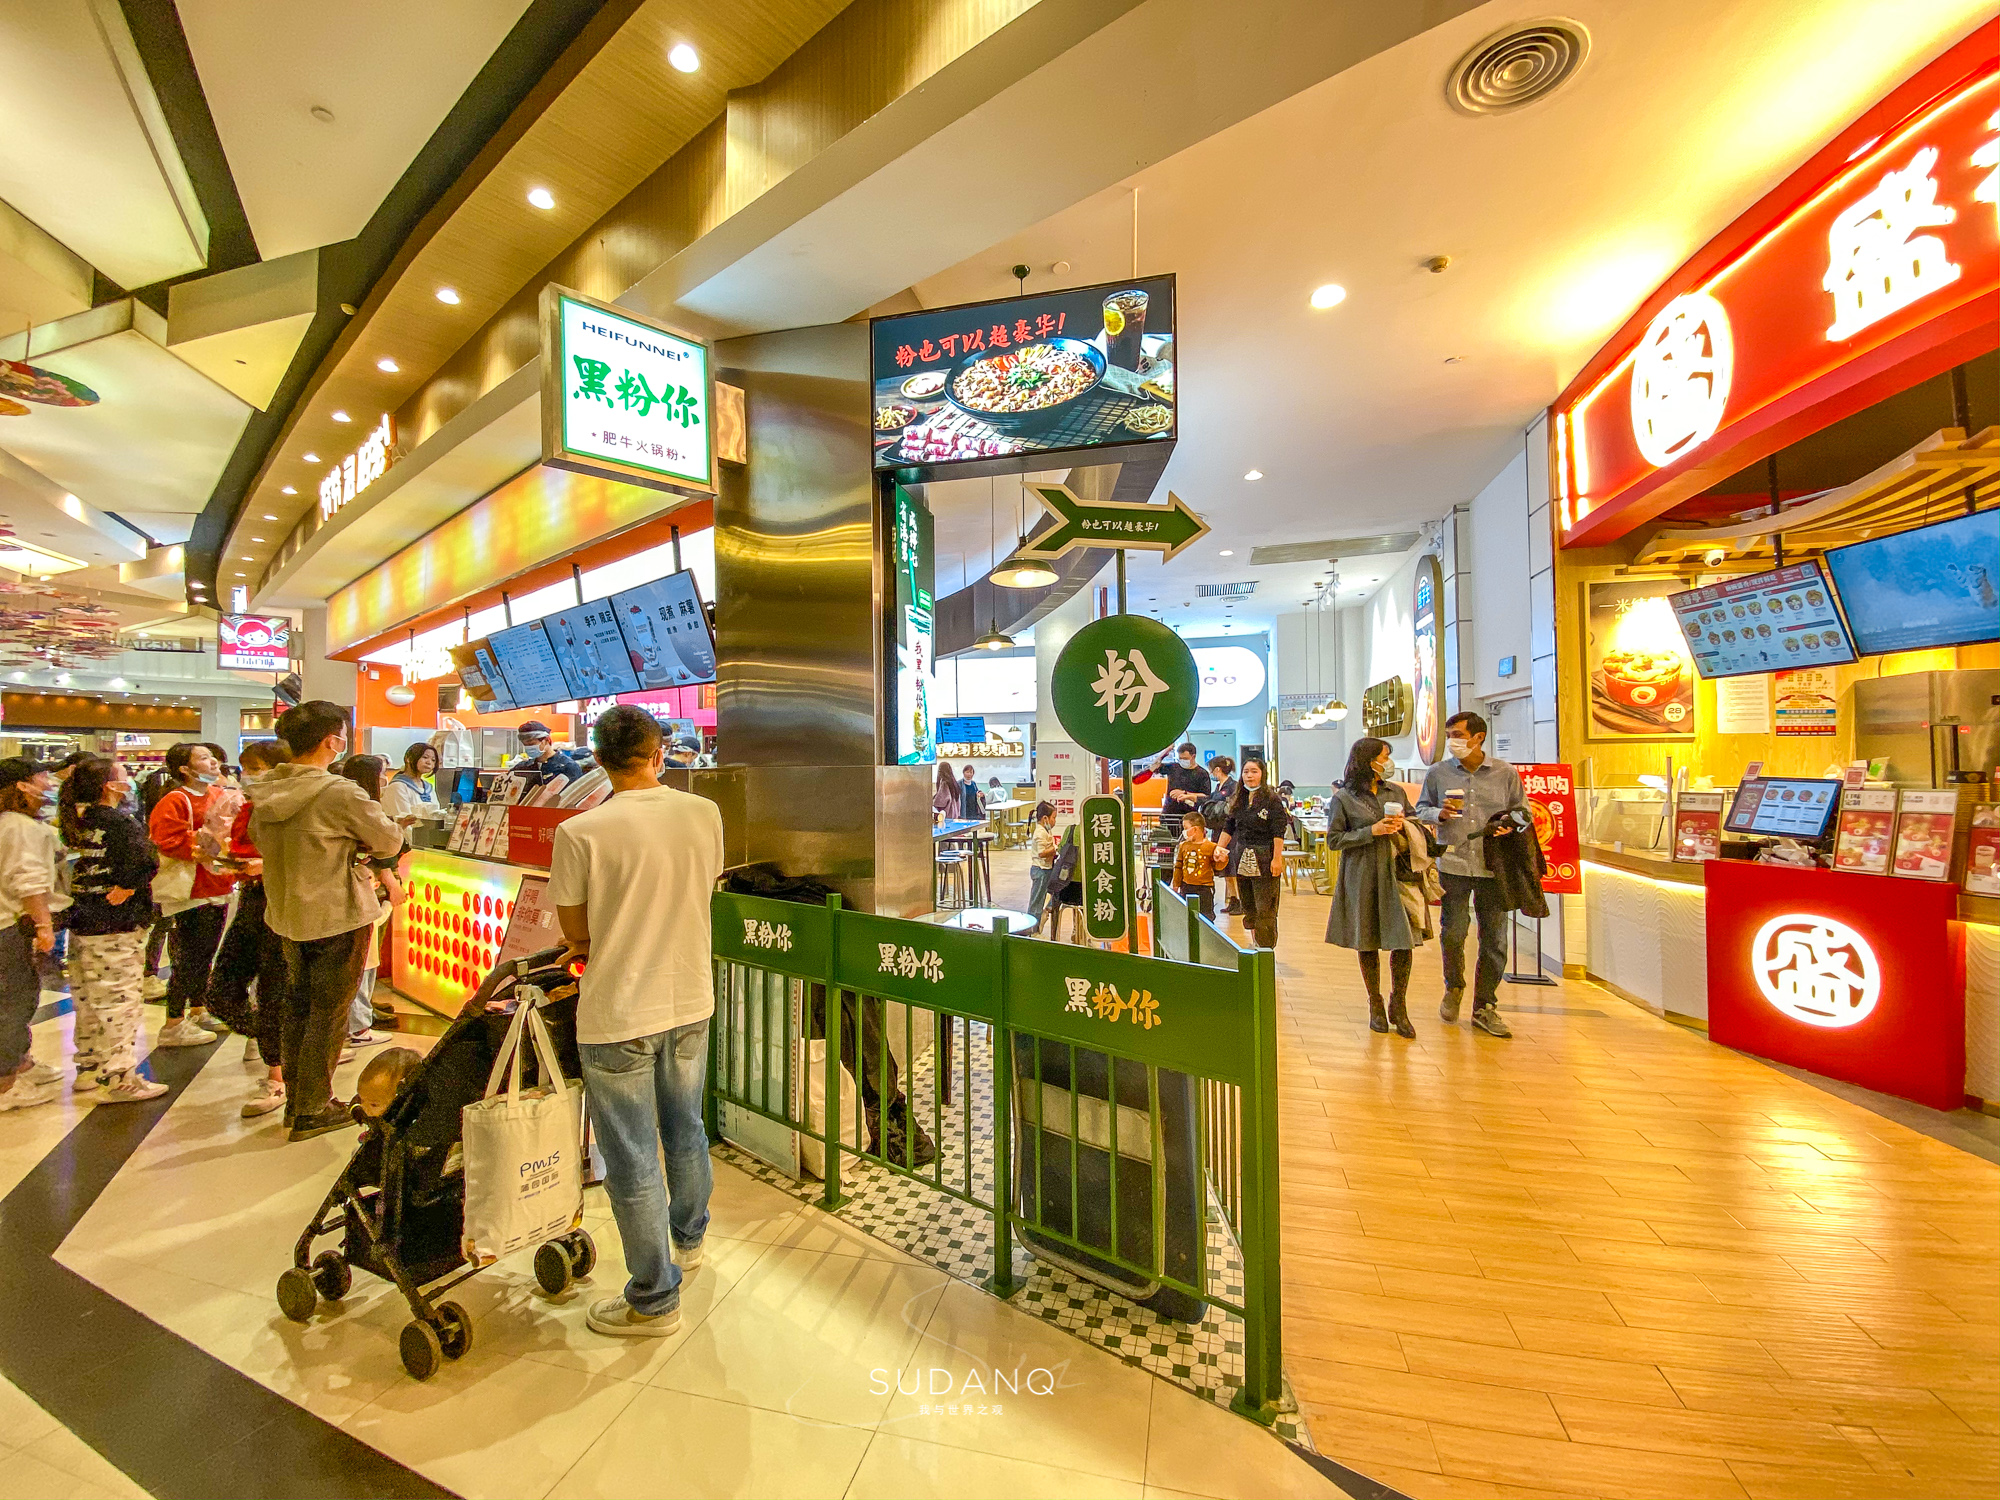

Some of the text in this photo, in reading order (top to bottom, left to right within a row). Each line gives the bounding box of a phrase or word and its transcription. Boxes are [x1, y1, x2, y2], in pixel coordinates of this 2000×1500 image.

[894, 311, 1066, 369] 粉也可以超豪华!
[572, 354, 701, 429] 黑粉你
[602, 430, 679, 461] 肥牛火锅粉
[1089, 648, 1170, 725] 粉
[743, 917, 793, 952] 黑粉你
[878, 942, 945, 984] 黑粉你
[1064, 976, 1162, 1030] 黑粉你
